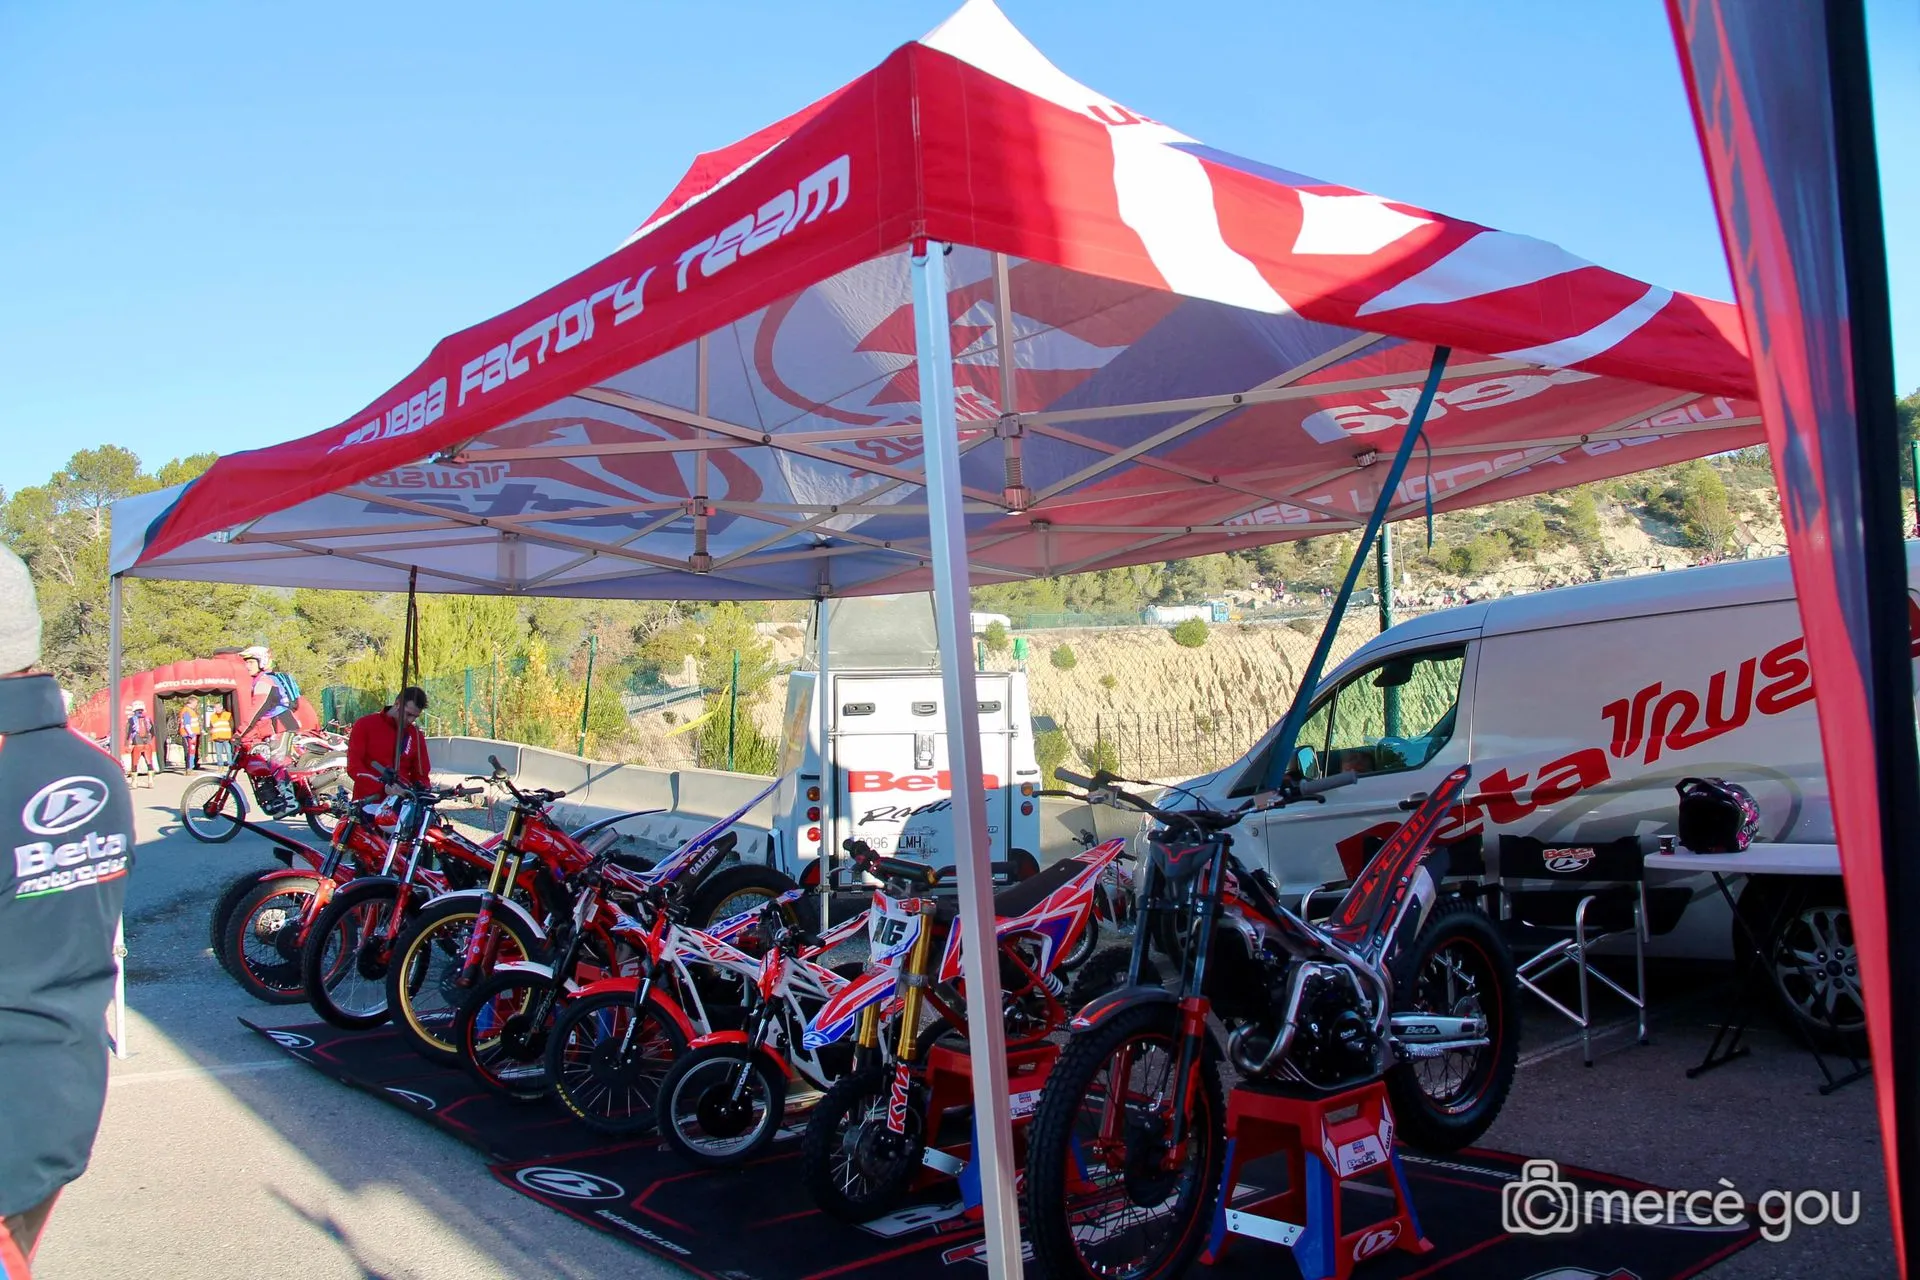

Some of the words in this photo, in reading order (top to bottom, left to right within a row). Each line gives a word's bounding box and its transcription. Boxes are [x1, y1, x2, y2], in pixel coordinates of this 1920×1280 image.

[15, 832, 127, 877] Beta
[898, 835, 921, 849] LMH
[689, 845, 719, 875] GALFER
[872, 915, 908, 946] 16
[1404, 1026, 1437, 1034] Beta
[887, 1061, 910, 1135] KYB
